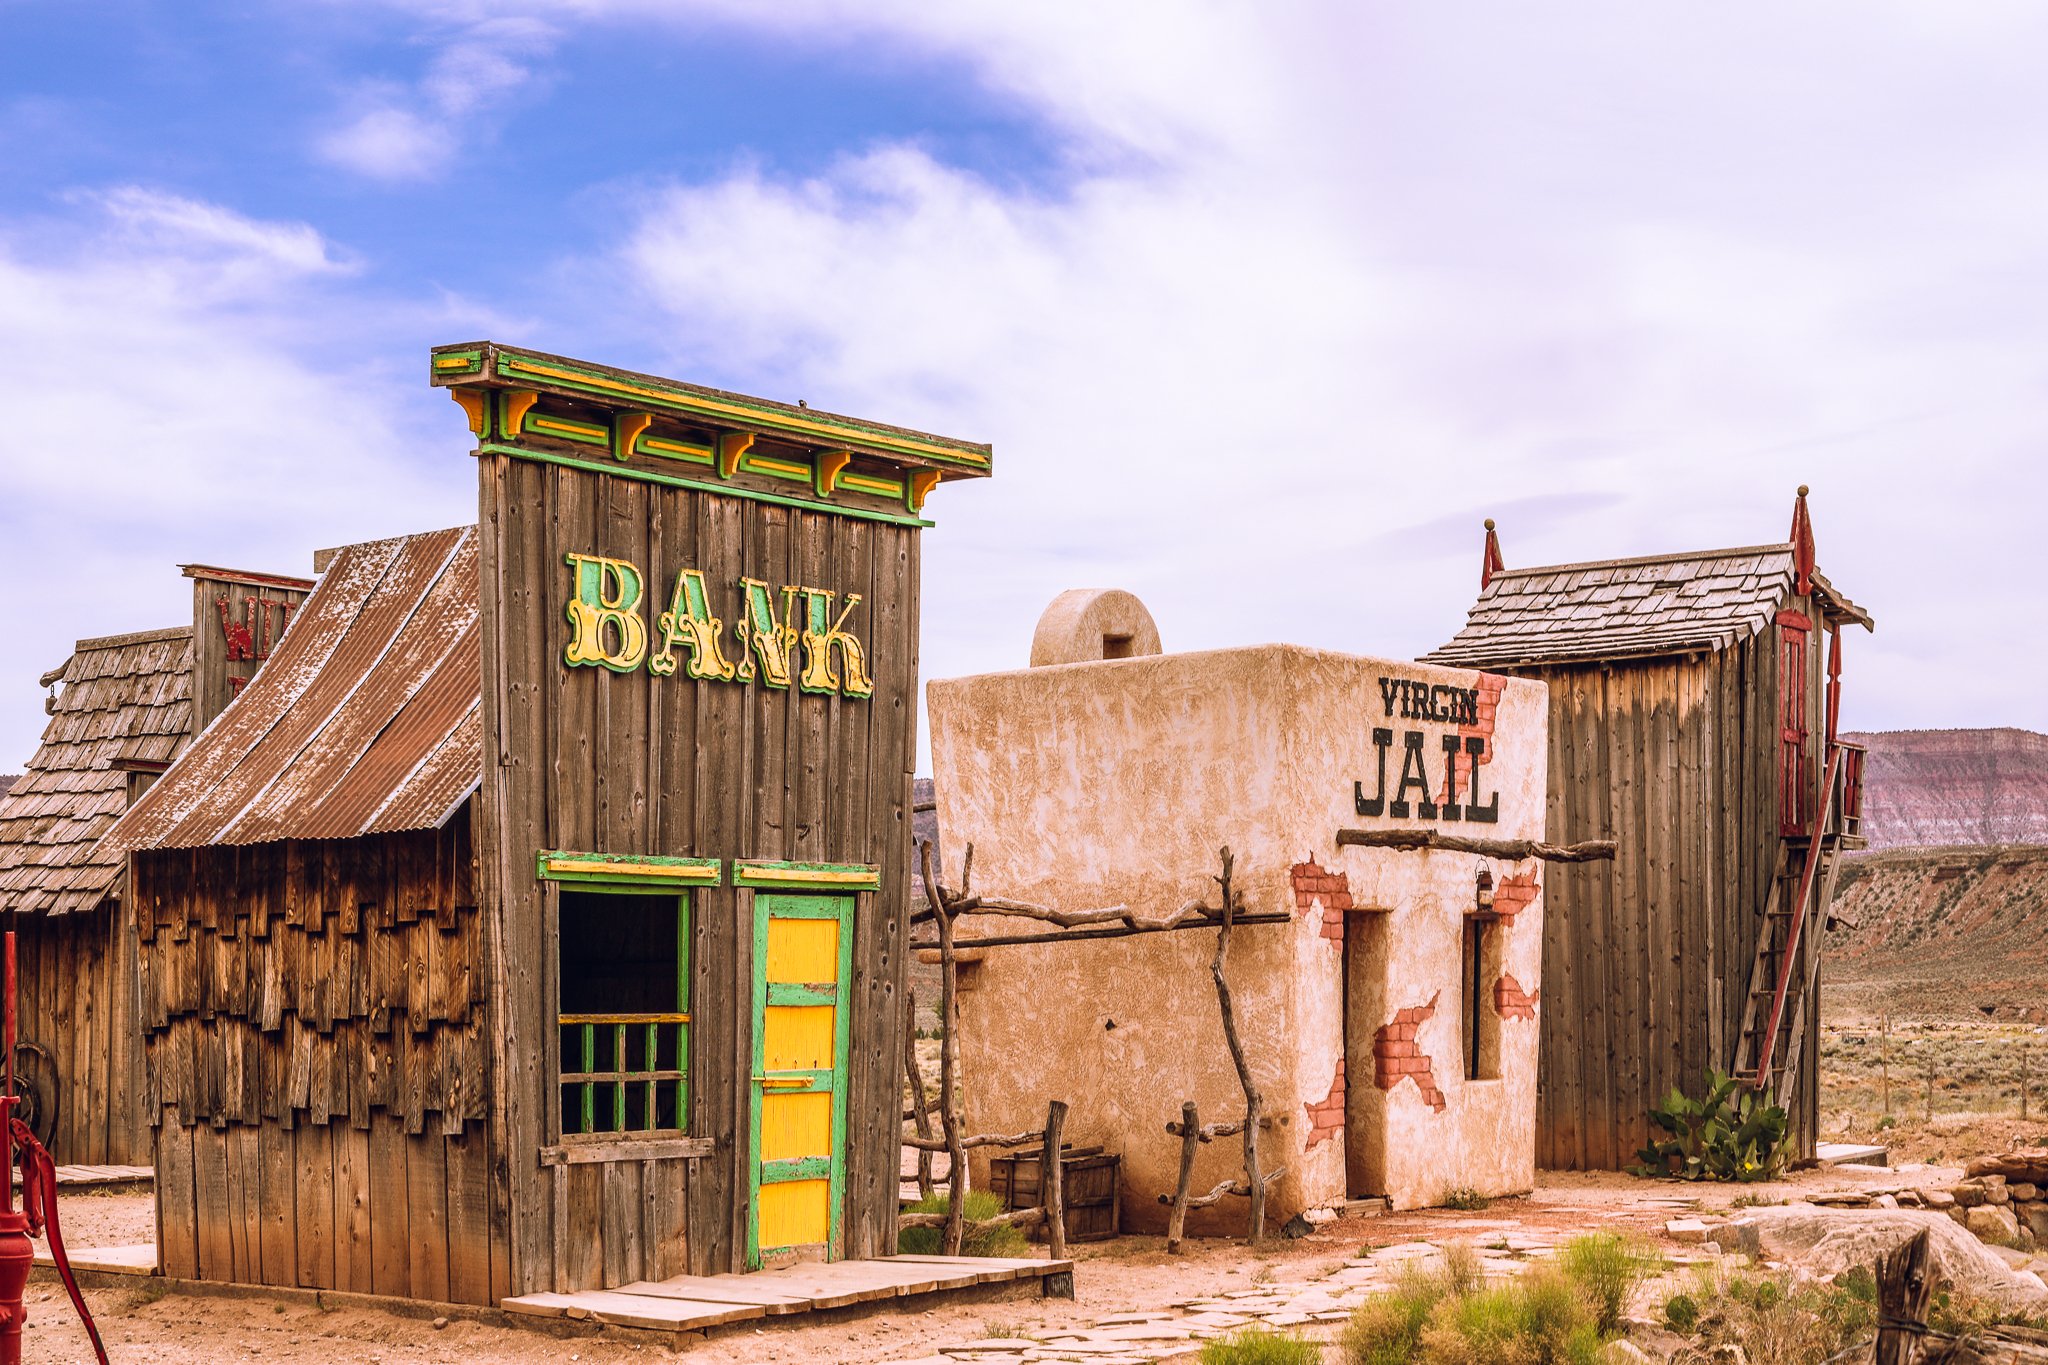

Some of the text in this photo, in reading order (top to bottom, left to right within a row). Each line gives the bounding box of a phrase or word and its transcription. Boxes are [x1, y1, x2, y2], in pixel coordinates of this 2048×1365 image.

[565, 553, 873, 699] BANK
[1378, 676, 1479, 725] VIRGIN
[1354, 727, 1499, 823] JAIL
